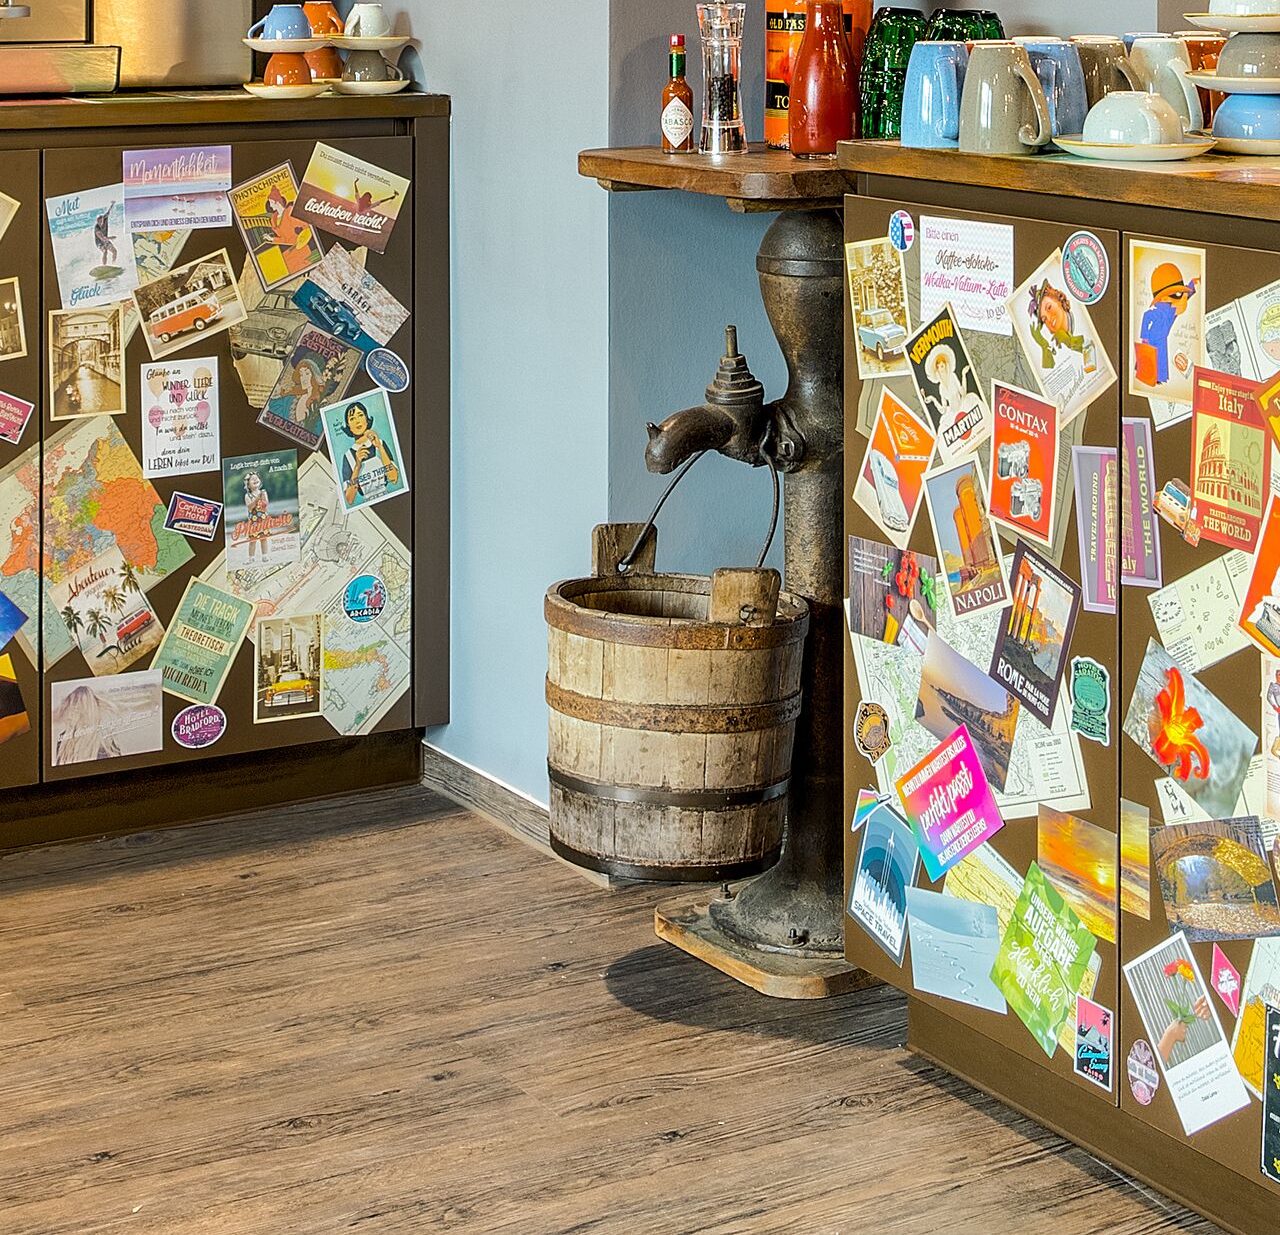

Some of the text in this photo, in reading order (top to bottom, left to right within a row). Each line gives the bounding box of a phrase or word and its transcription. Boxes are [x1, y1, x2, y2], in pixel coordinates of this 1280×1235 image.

[662, 117, 692, 126] TABASCO
[232, 171, 290, 203] PHOTOCHROME
[55, 197, 81, 217] Mut
[304, 198, 386, 229] liebhaben reicht!
[69, 284, 101, 308] Glück
[340, 282, 373, 312] GARAGE
[910, 319, 953, 365] VERMOUTH
[999, 404, 1048, 434] CONTAX
[1218, 394, 1244, 420] Italy
[943, 405, 983, 446] MARTINI
[179, 500, 208, 514] Carlton
[185, 512, 208, 522] Hotel
[193, 591, 241, 622] DIE TRAGIK
[350, 607, 381, 618] ARCADIA
[956, 584, 1004, 612] NAPOLI
[180, 626, 226, 653] THEORETISCH
[997, 657, 1024, 692] ROME
[179, 716, 220, 736] BRADFORD
[854, 901, 898, 950] SPACE TRAVEL
[1024, 908, 1073, 974] AUFGABE
